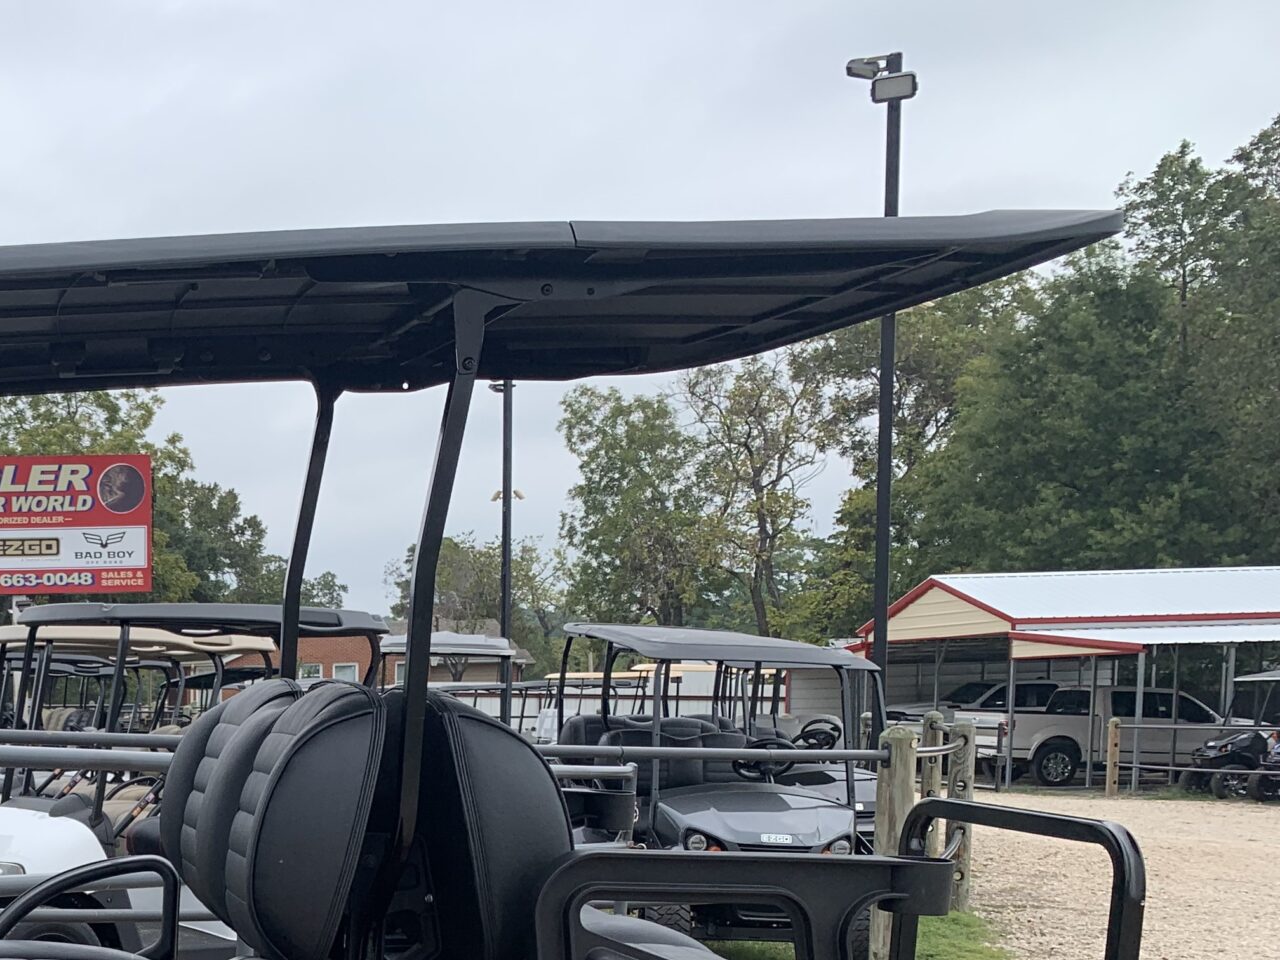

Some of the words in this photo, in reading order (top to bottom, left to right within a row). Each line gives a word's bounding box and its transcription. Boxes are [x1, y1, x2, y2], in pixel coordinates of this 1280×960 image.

[11, 495, 93, 513] WORLD
[30, 515, 64, 524] DEALER
[75, 551, 102, 560] BAD
[107, 550, 134, 559] BOY
[101, 571, 133, 579] SALES
[136, 570, 144, 578] &
[101, 578, 145, 587] SERVICE
